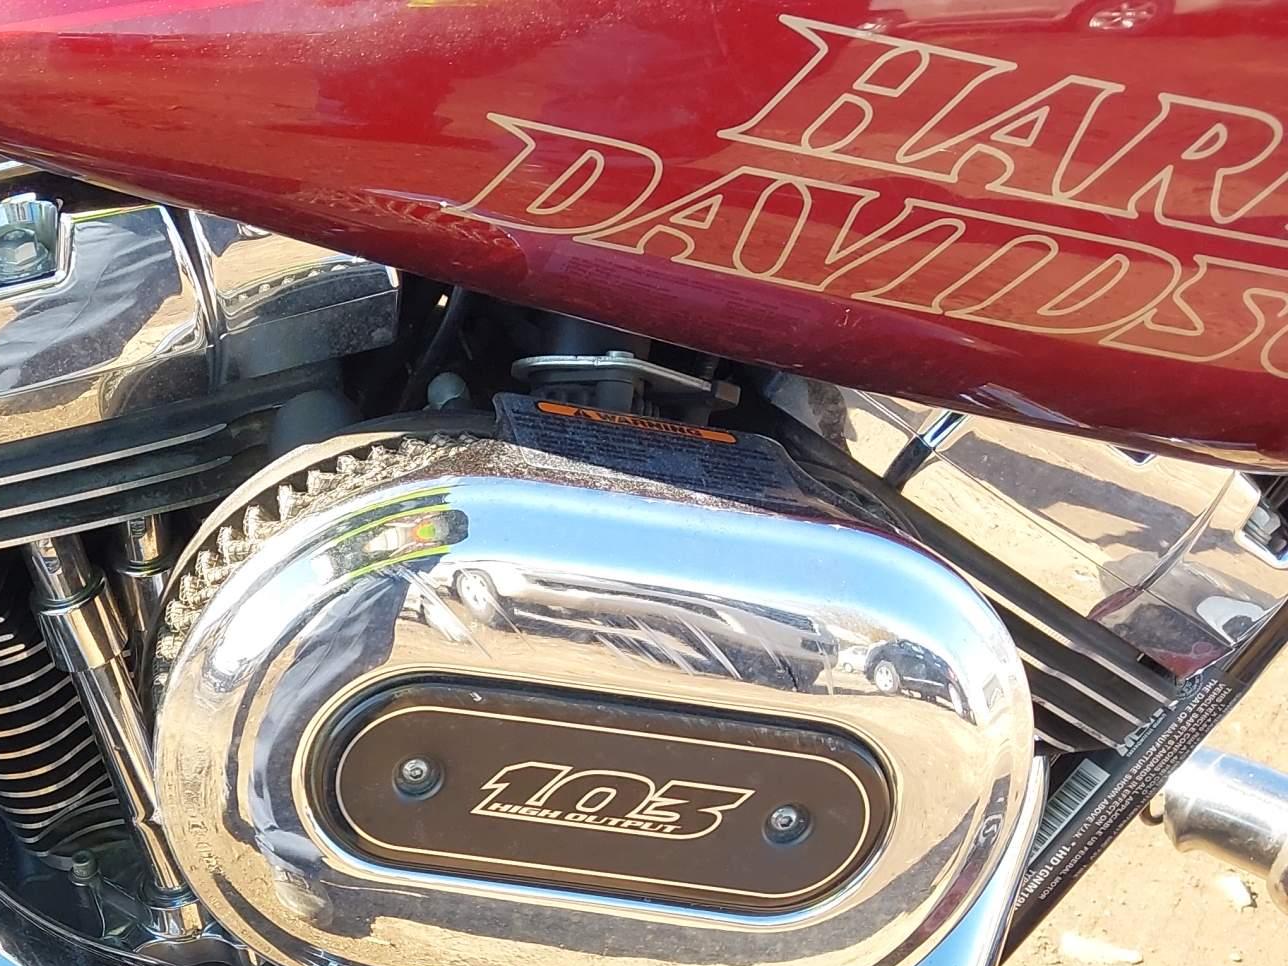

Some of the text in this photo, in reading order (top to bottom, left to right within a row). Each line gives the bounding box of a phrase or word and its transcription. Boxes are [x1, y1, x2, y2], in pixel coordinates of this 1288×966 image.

[439, 112, 1288, 381] DAVIDS
[597, 412, 702, 436] WARNING
[1195, 680, 1227, 715] VEHICLE
[1200, 676, 1219, 695] THE
[1214, 684, 1233, 704] THIS
[1174, 709, 1188, 724] OF
[1183, 690, 1205, 714] DATE
[1171, 711, 1199, 741] SAFETY
[1187, 701, 1218, 734] VEHICLE
[1128, 720, 1179, 775] MANUFACTURE
[1134, 737, 1175, 782] STANDARDS
[1152, 730, 1191, 773] CONFORMS
[1105, 771, 1133, 801] SHOWN
[1126, 778, 1138, 790] IN
[1130, 780, 1146, 797] ALL
[1142, 770, 1156, 783] TO
[471, 761, 756, 840] 103
[1084, 797, 1110, 824] ABOVE
[1094, 793, 1134, 837] APPLICABLE
[1103, 786, 1131, 815] EFFECT
[488, 802, 682, 832] HIGH OUTPUT
[1093, 812, 1107, 827] ON
[1057, 844, 1088, 877] FEDERAL
[1036, 873, 1062, 901] MOTOR
